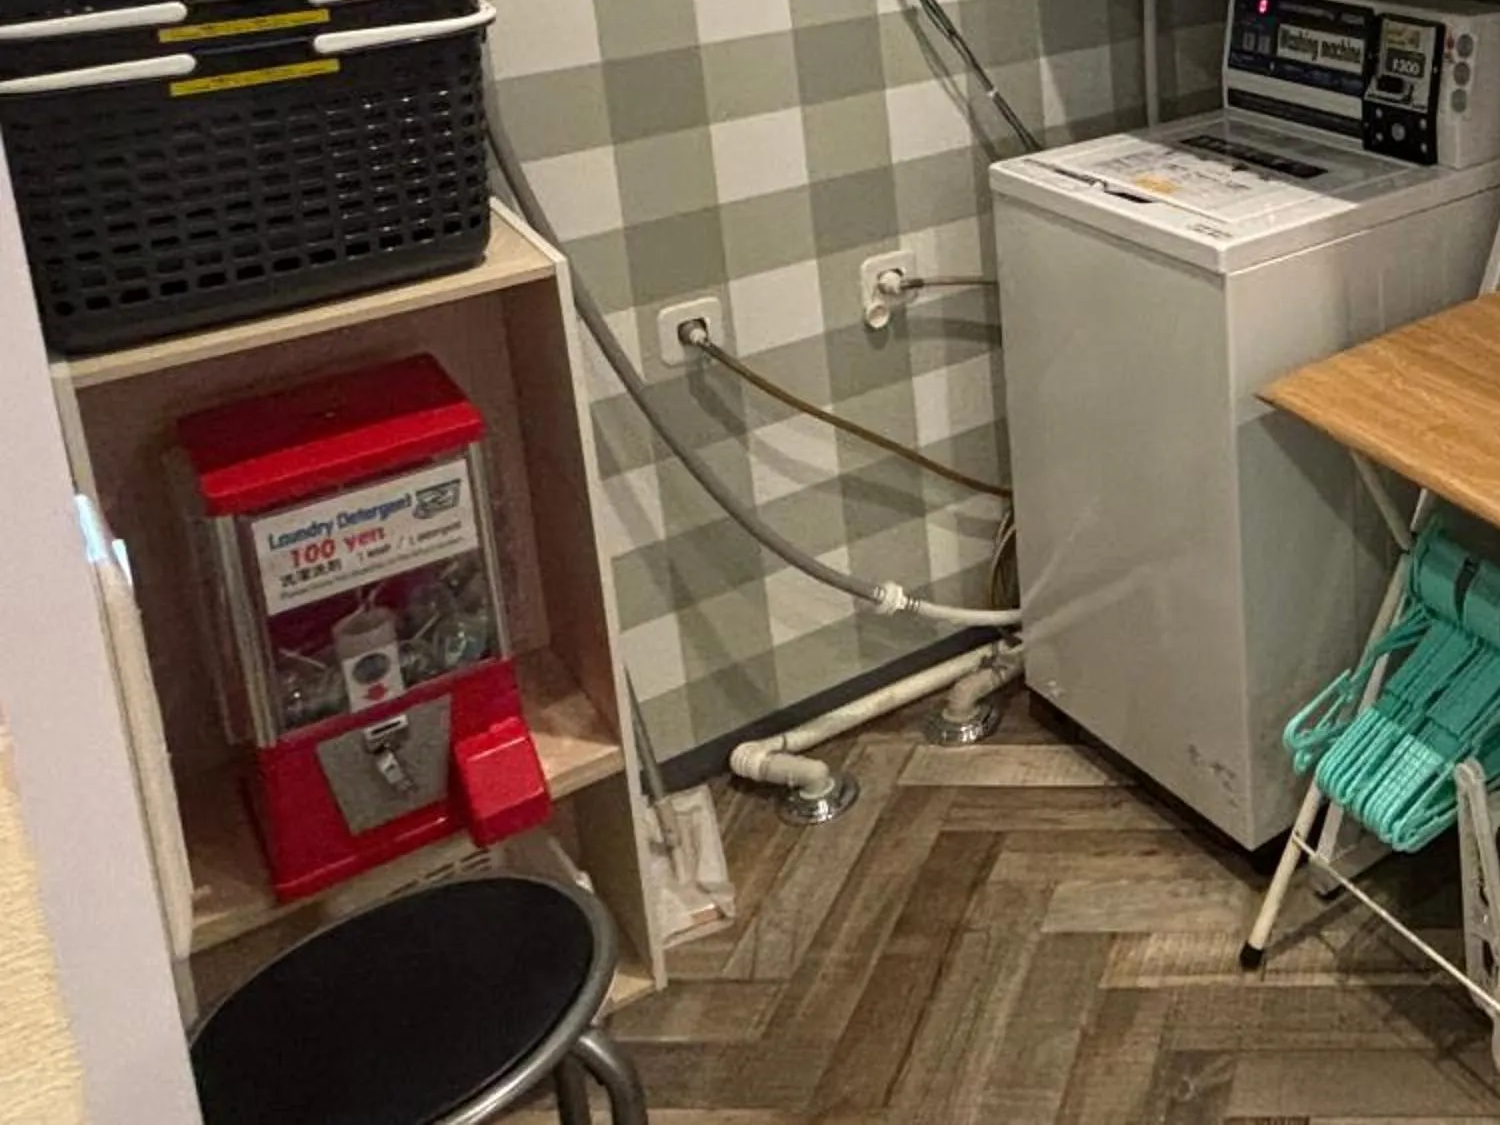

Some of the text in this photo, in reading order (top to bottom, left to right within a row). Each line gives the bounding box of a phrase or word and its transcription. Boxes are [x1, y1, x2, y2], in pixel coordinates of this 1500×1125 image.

[268, 518, 334, 551] Laundry
[336, 492, 412, 528] Detergent
[290, 539, 336, 568] 100
[343, 527, 385, 553] yen
